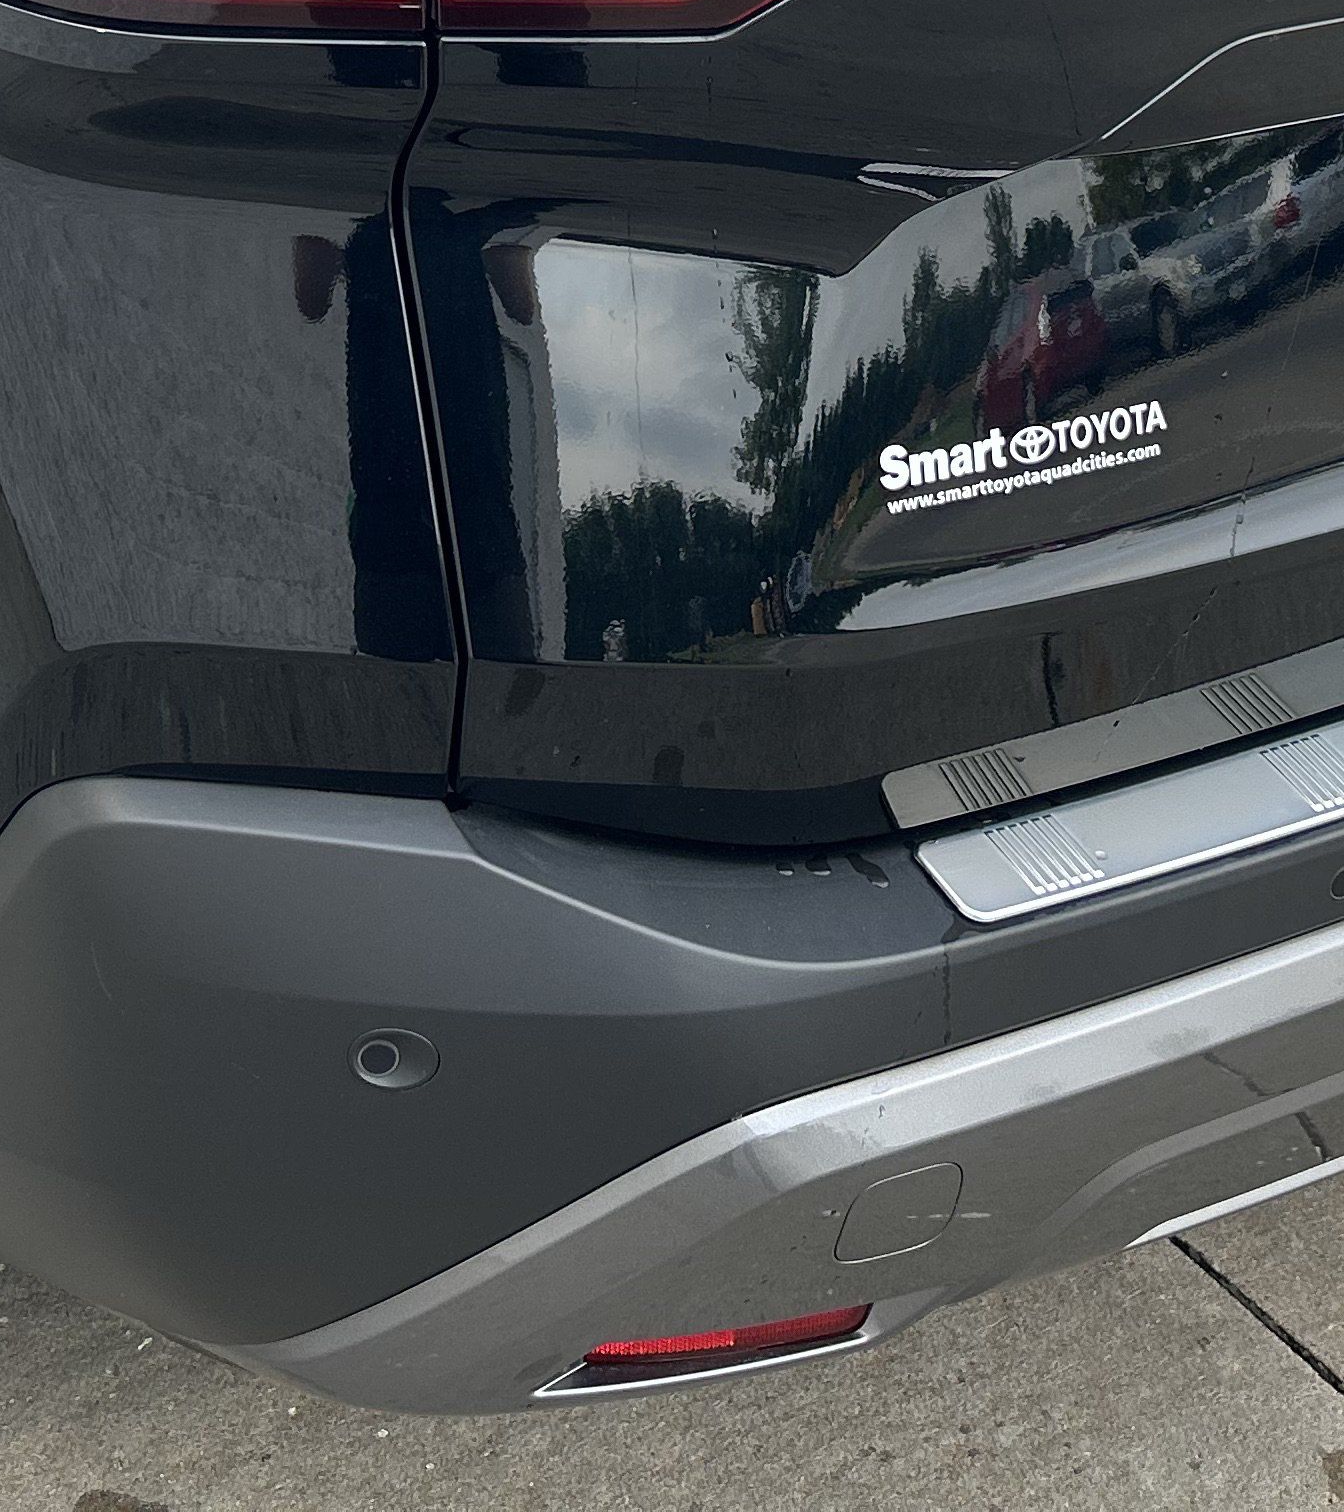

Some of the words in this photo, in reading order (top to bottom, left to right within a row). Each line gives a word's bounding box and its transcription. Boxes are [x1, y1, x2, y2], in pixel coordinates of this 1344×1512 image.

[879, 427, 1008, 491] Smart
[1051, 399, 1169, 454] TOYOTA
[886, 443, 1161, 515] www.smarttoyotaquadcities.com
